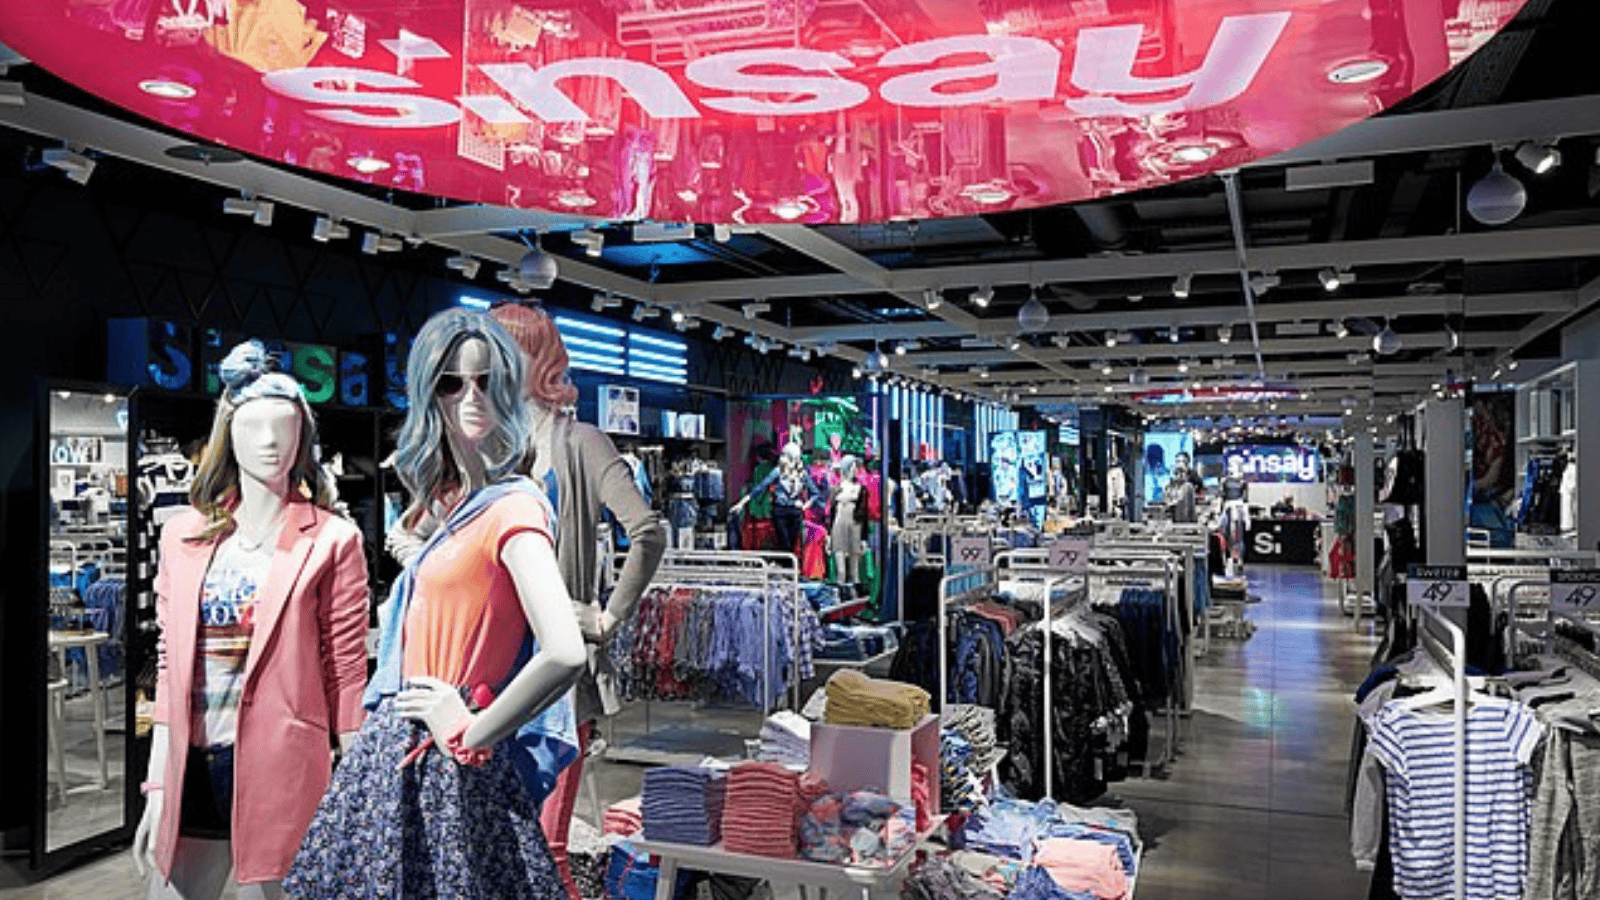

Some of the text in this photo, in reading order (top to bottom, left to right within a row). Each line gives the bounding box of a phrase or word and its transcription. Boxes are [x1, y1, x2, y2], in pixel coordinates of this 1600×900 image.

[262, 11, 1292, 127] sinsay
[1254, 525, 1282, 554] Si
[1057, 550, 1077, 566] 79
[1422, 583, 1453, 601] 49
[1565, 586, 1597, 606] 49
